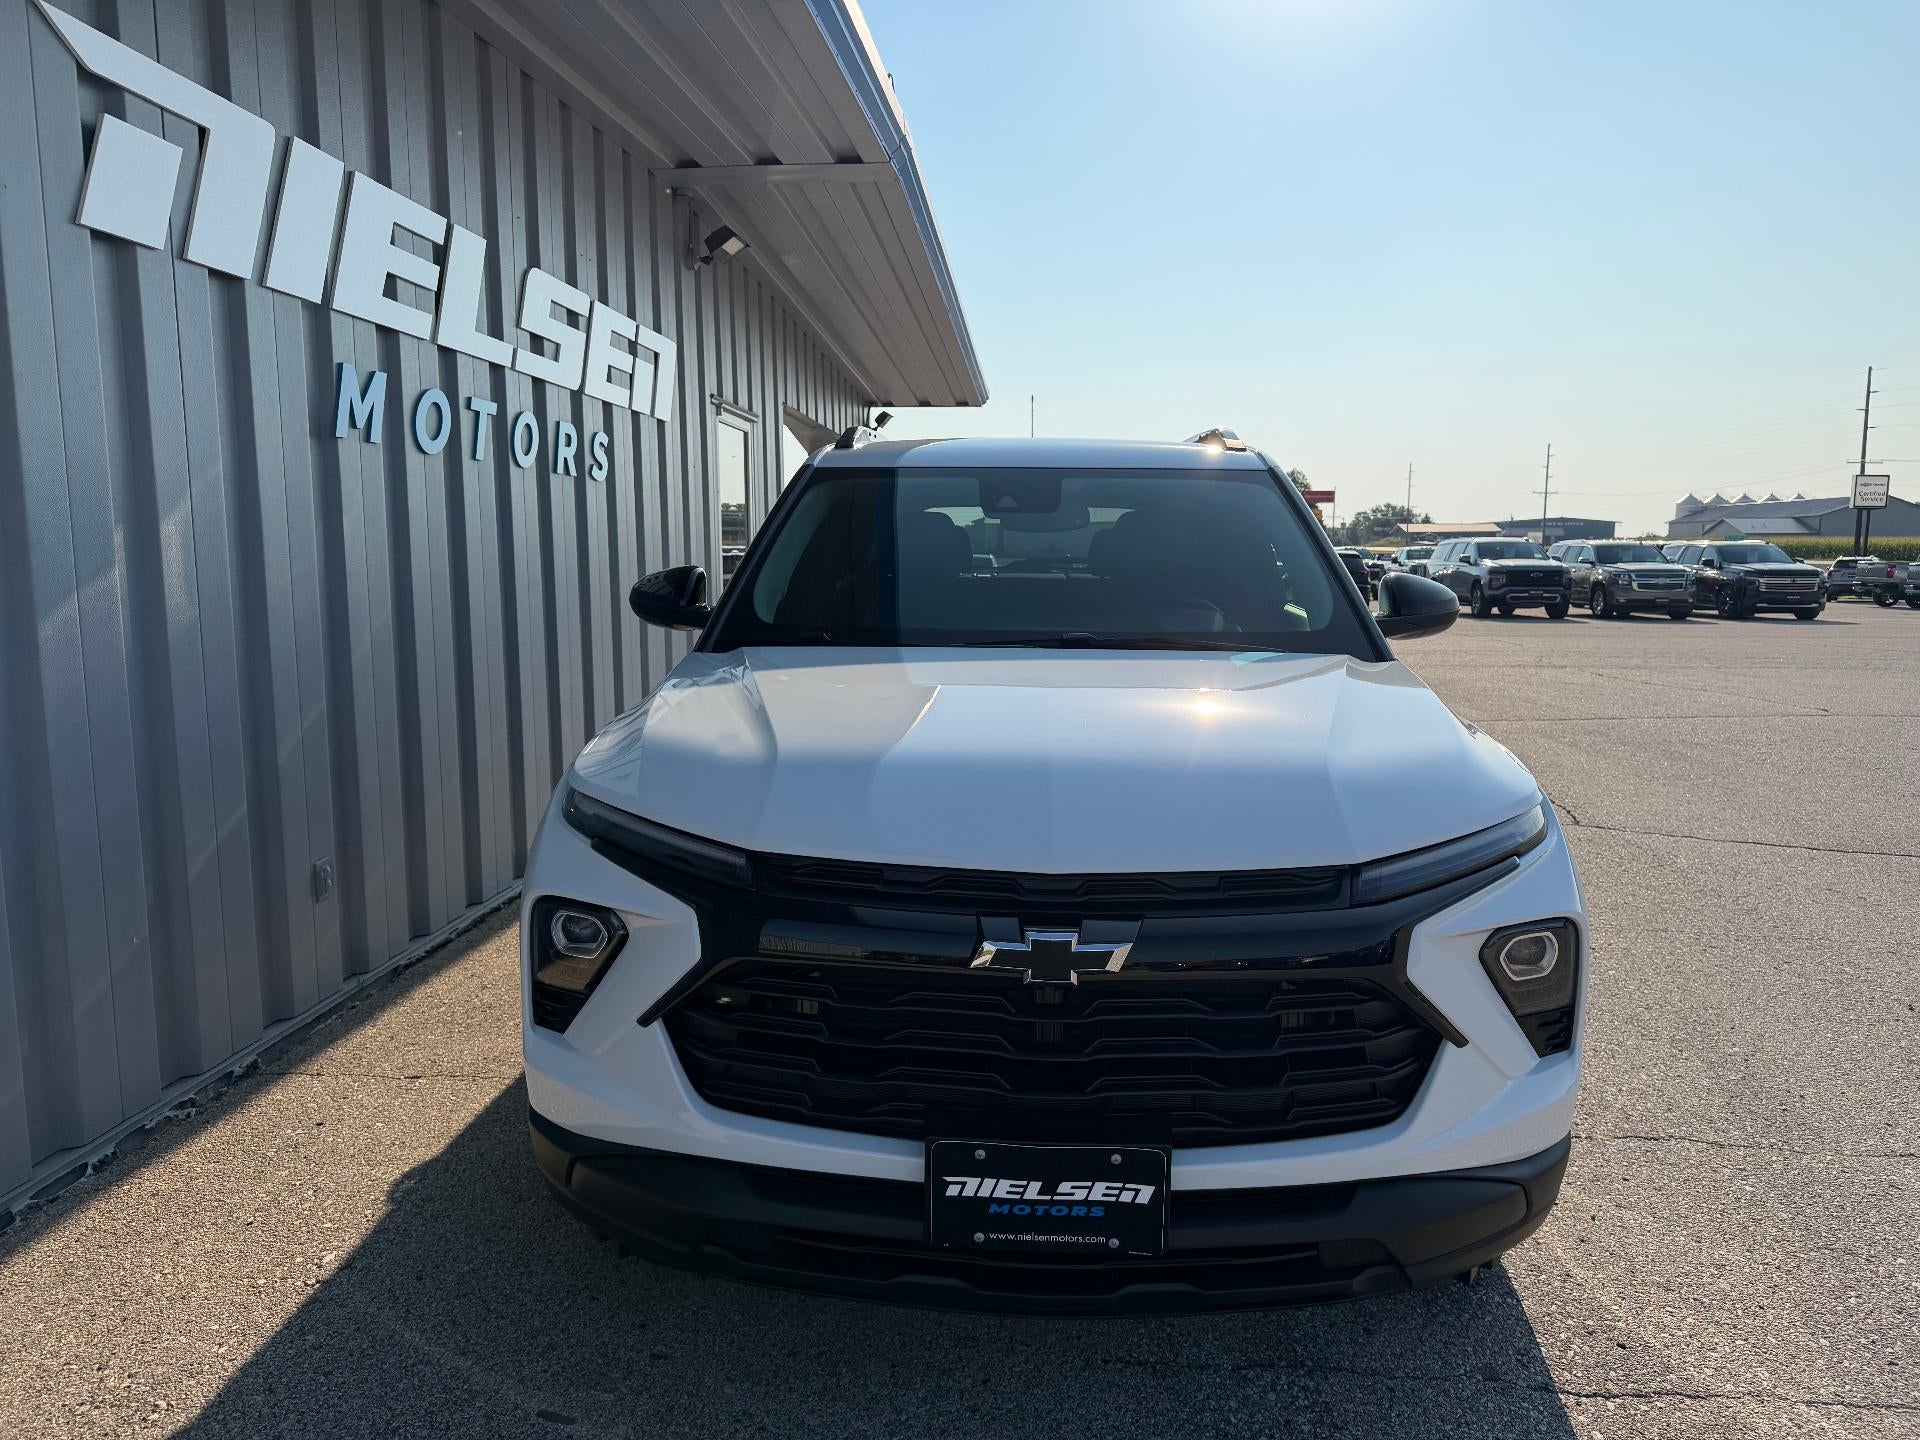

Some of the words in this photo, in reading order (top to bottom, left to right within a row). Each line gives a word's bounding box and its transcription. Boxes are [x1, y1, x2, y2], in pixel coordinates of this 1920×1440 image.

[34, 0, 678, 422] NIELSEN
[335, 362, 609, 482] MOTORS
[942, 1176, 1155, 1205] NIELSEN
[989, 1203, 1105, 1217] MOTORS
[989, 1231, 1106, 1244] www.nielsenmotors.com
